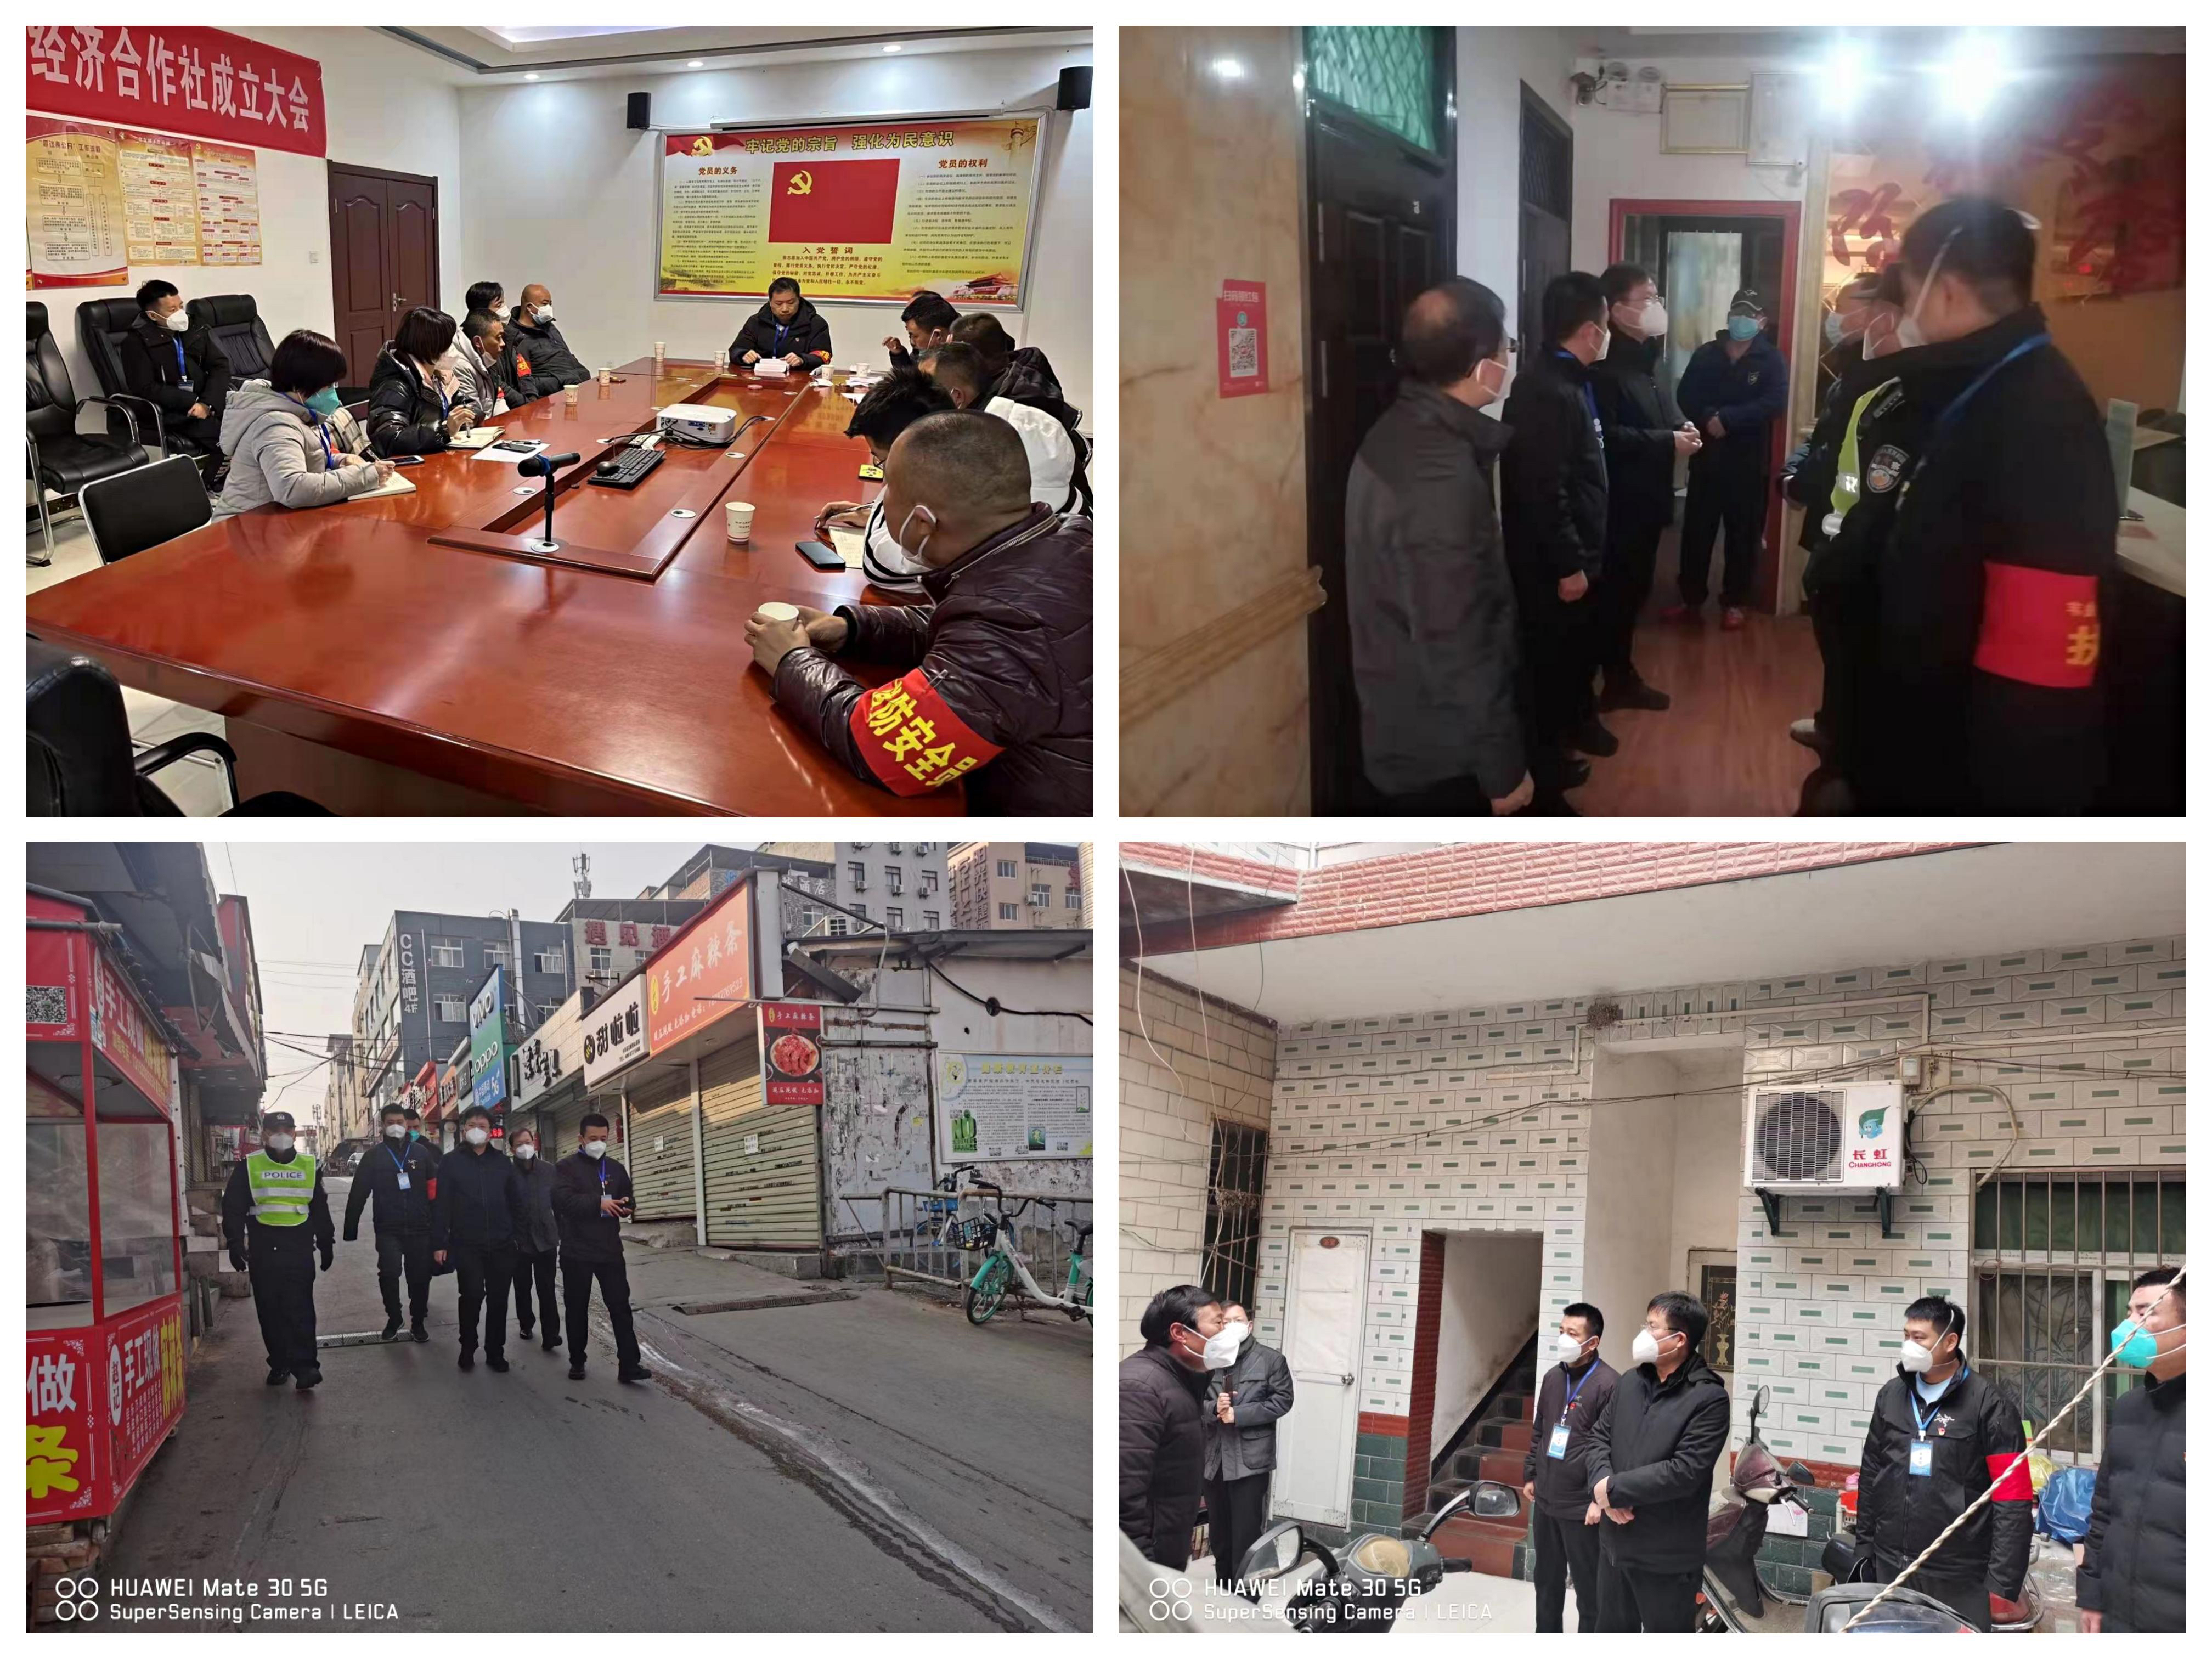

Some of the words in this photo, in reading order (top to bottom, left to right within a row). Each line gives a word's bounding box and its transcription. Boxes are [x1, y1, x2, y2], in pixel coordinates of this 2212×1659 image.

[26, 26, 309, 132] 经济合作社成立大会
[745, 135, 838, 154] 牢记党的宗旨
[852, 131, 954, 150] 强化为民意识
[698, 166, 738, 176] 党员的义务
[939, 158, 988, 168] 党员的权利
[471, 990, 493, 1029] vivo
[596, 1001, 640, 1057] 甜啦啦
[1852, 1149, 1887, 1160] 长虹
[26, 1353, 77, 1417] 做
